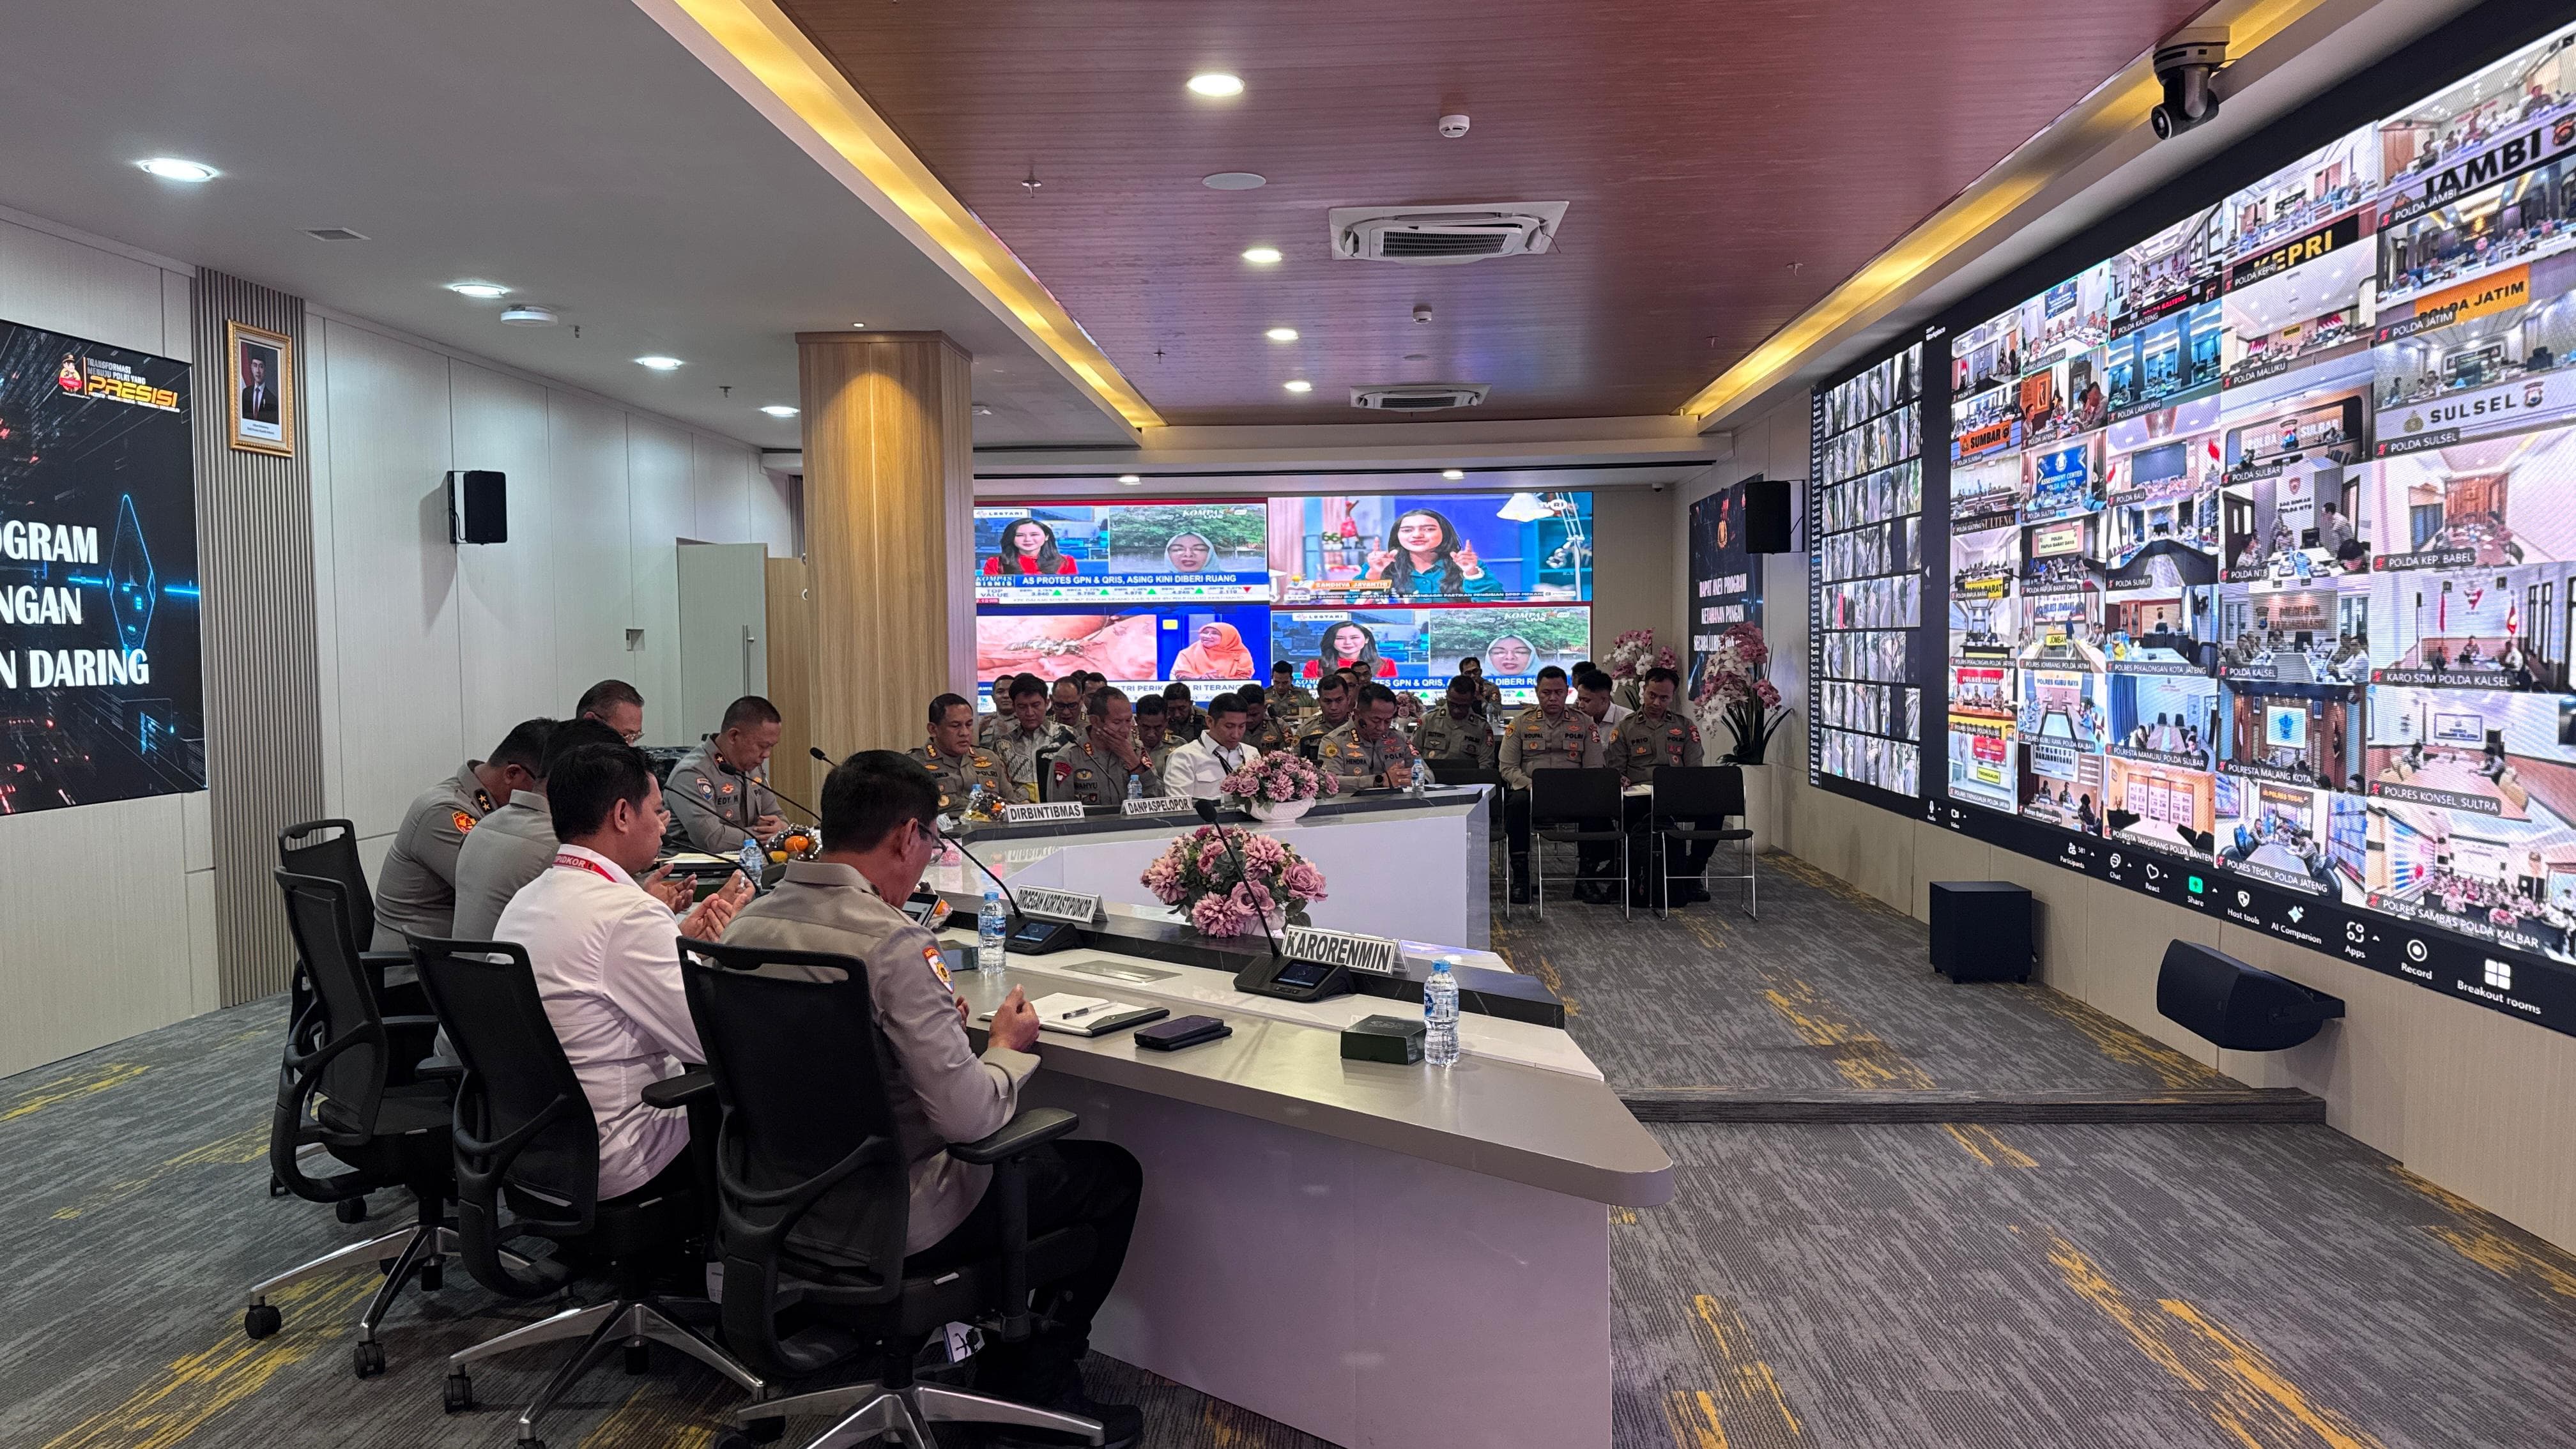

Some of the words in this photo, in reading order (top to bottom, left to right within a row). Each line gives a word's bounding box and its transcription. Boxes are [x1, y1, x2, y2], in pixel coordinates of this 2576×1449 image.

[2395, 203, 2426, 221] POLDA
[2427, 190, 2458, 208] JAMBI
[2235, 272, 2257, 287] POLDA
[2473, 280, 2525, 307] JATIM
[2118, 324, 2135, 335] POLDA
[2135, 313, 2159, 328] KALTENG
[2393, 321, 2424, 337] POLDA
[2426, 310, 2453, 328] JATIM
[2233, 371, 2255, 384] POLDA
[2256, 362, 2286, 378] MALUKU
[88, 376, 178, 408] PRESISI
[2117, 408, 2134, 419] POLDA
[2135, 401, 2161, 415] LAMPUNG
[2430, 394, 2517, 424] SULSEL
[1970, 428, 2001, 449] SUMBAR
[2028, 436, 2041, 445] POLDA
[2391, 439, 2421, 454] POLDA
[2423, 433, 2458, 447] SULSEL
[2041, 473, 2066, 485] ASSESSMENT
[2066, 470, 2083, 480] CENTER
[2232, 470, 2254, 481] POLDA
[2255, 466, 2281, 478] SULBAR
[2116, 494, 2133, 503] POLDA
[2133, 492, 2145, 500] BALI
[1981, 514, 2014, 530] SULTENG
[0, 519, 98, 564] GRAM
[2389, 556, 2419, 567] POLDA
[2442, 553, 2472, 564] BABEL
[1073, 576, 1092, 585] GPN
[1102, 576, 1125, 585] QRIS,
[1126, 576, 1153, 584] ASING
[1156, 575, 1173, 583] KINI
[1206, 574, 1237, 583] RUANG
[2231, 571, 2253, 579] POLDA
[2254, 569, 2267, 578] NTB
[2115, 579, 2133, 587] POLDA
[2133, 578, 2150, 586] SUMUT
[29, 648, 150, 688] DARING
[2133, 664, 2168, 673] PEKALONGAN
[2230, 667, 2251, 677] POLDA
[2252, 668, 2276, 677] KALSEL
[2386, 673, 2412, 683] KARO
[2414, 674, 2436, 684] SDM
[2439, 675, 2471, 685] POLDA
[2474, 676, 2511, 687] KALSEL
[1631, 737, 1649, 746] PRIO
[1384, 752, 1405, 760] POLRI
[2113, 747, 2137, 757] POLRESTA
[2182, 757, 2204, 767] SULBAR
[2228, 763, 2260, 777] POLRESTA
[2260, 767, 2290, 781] MALANG
[2292, 772, 2312, 784] KOTA
[717, 797, 731, 805] EDY
[2384, 786, 2418, 800] POLRES
[1010, 804, 1081, 821] DIRBINTIBMAS
[1128, 798, 1190, 814] DANPASPELOPOR
[2113, 830, 2136, 843] POLRESTA
[2137, 835, 2169, 852] TANGERANG
[2170, 844, 2188, 856] POLDA
[2189, 849, 2213, 863] BANTEN
[2060, 855, 2085, 870] Participants
[2110, 871, 2121, 881] Chat
[2227, 859, 2251, 872] POLRES
[2299, 878, 2328, 893] JATENG
[2145, 882, 2160, 893] React
[2187, 895, 2204, 907] Share
[2227, 907, 2243, 920] Host
[2244, 914, 2260, 925] tools
[2383, 900, 2417, 916] POLRES
[2418, 908, 2458, 927] SAMBAS
[2496, 929, 2539, 949] KALBAR
[2271, 922, 2279, 931] AI
[2280, 924, 2322, 944] Companion
[1284, 930, 1392, 970] KARORENMIN
[2344, 945, 2366, 959] Apps
[2400, 962, 2433, 980] Record
[2457, 979, 2504, 1003] Breakout
[2506, 996, 2542, 1015] rooms
